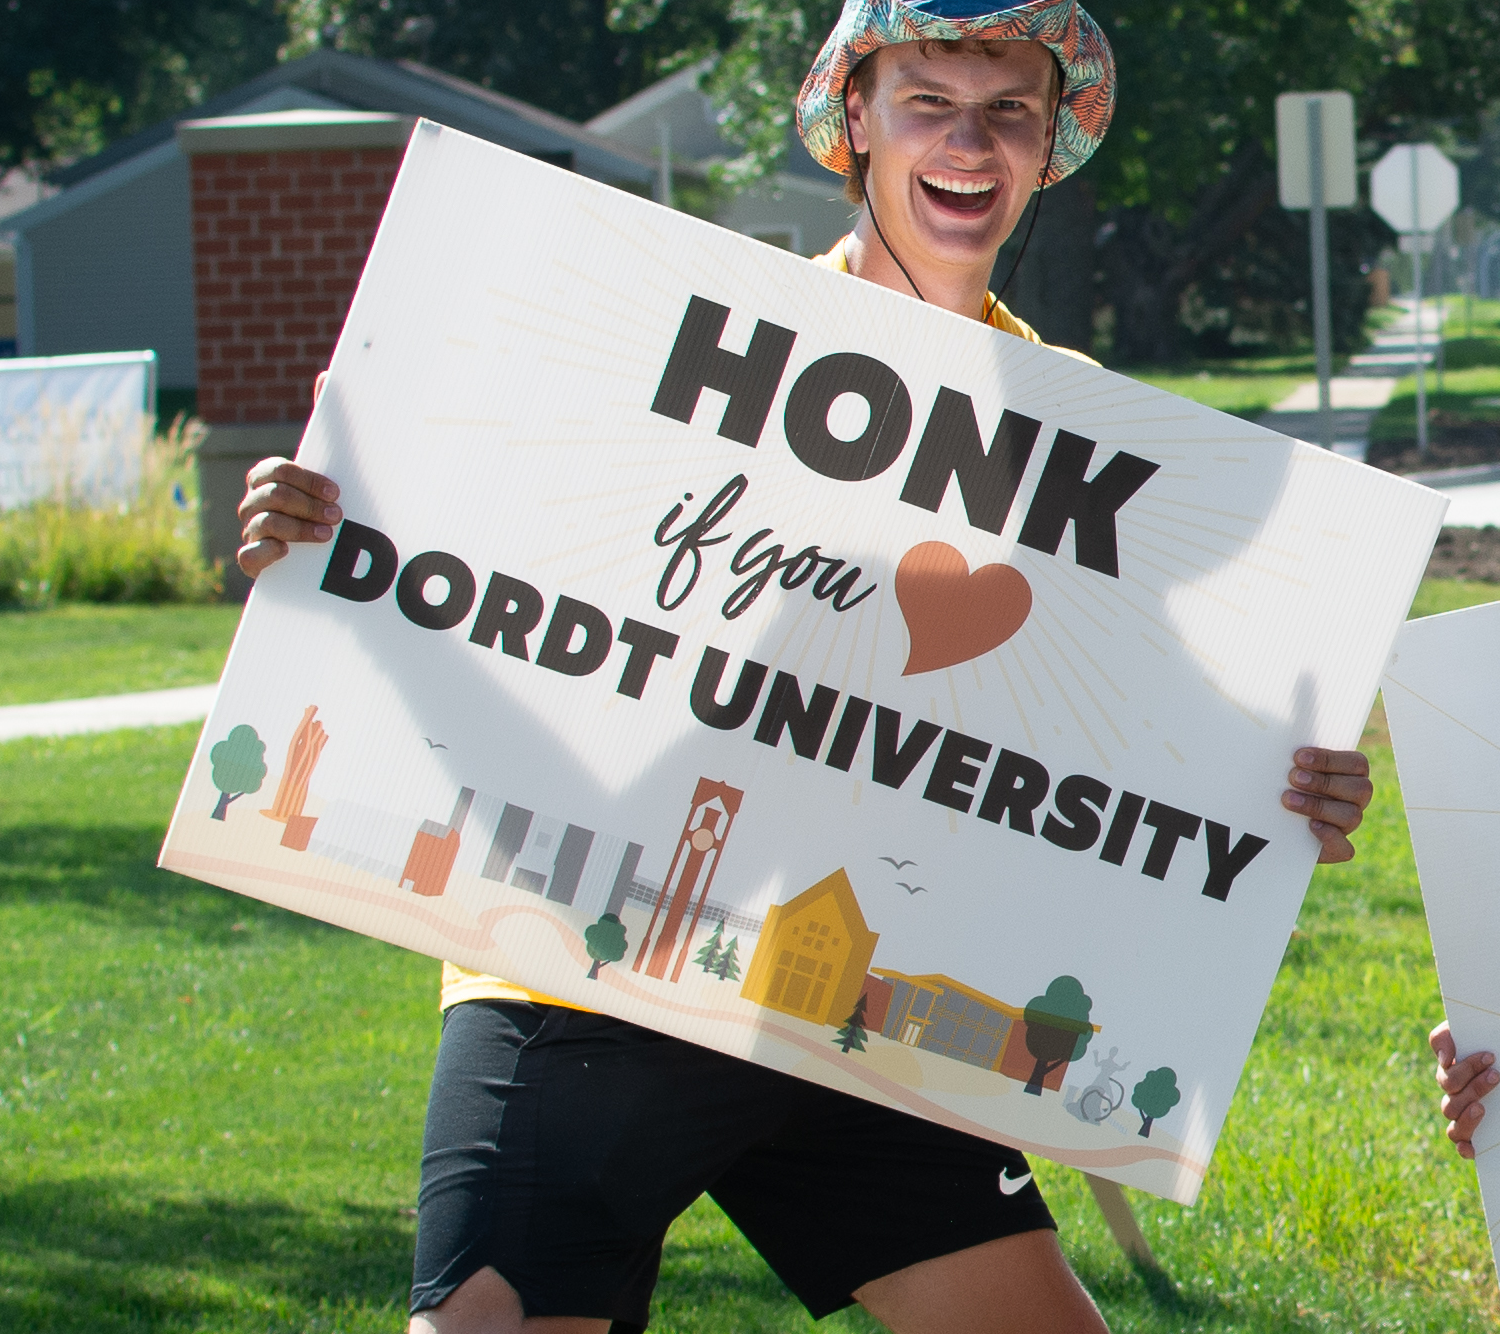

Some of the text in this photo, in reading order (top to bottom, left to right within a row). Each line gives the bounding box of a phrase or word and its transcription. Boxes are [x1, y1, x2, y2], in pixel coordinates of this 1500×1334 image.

[650, 294, 1161, 579] HONK
[654, 473, 878, 621] if you
[319, 518, 1270, 903] DORDT UNIVERSITY
